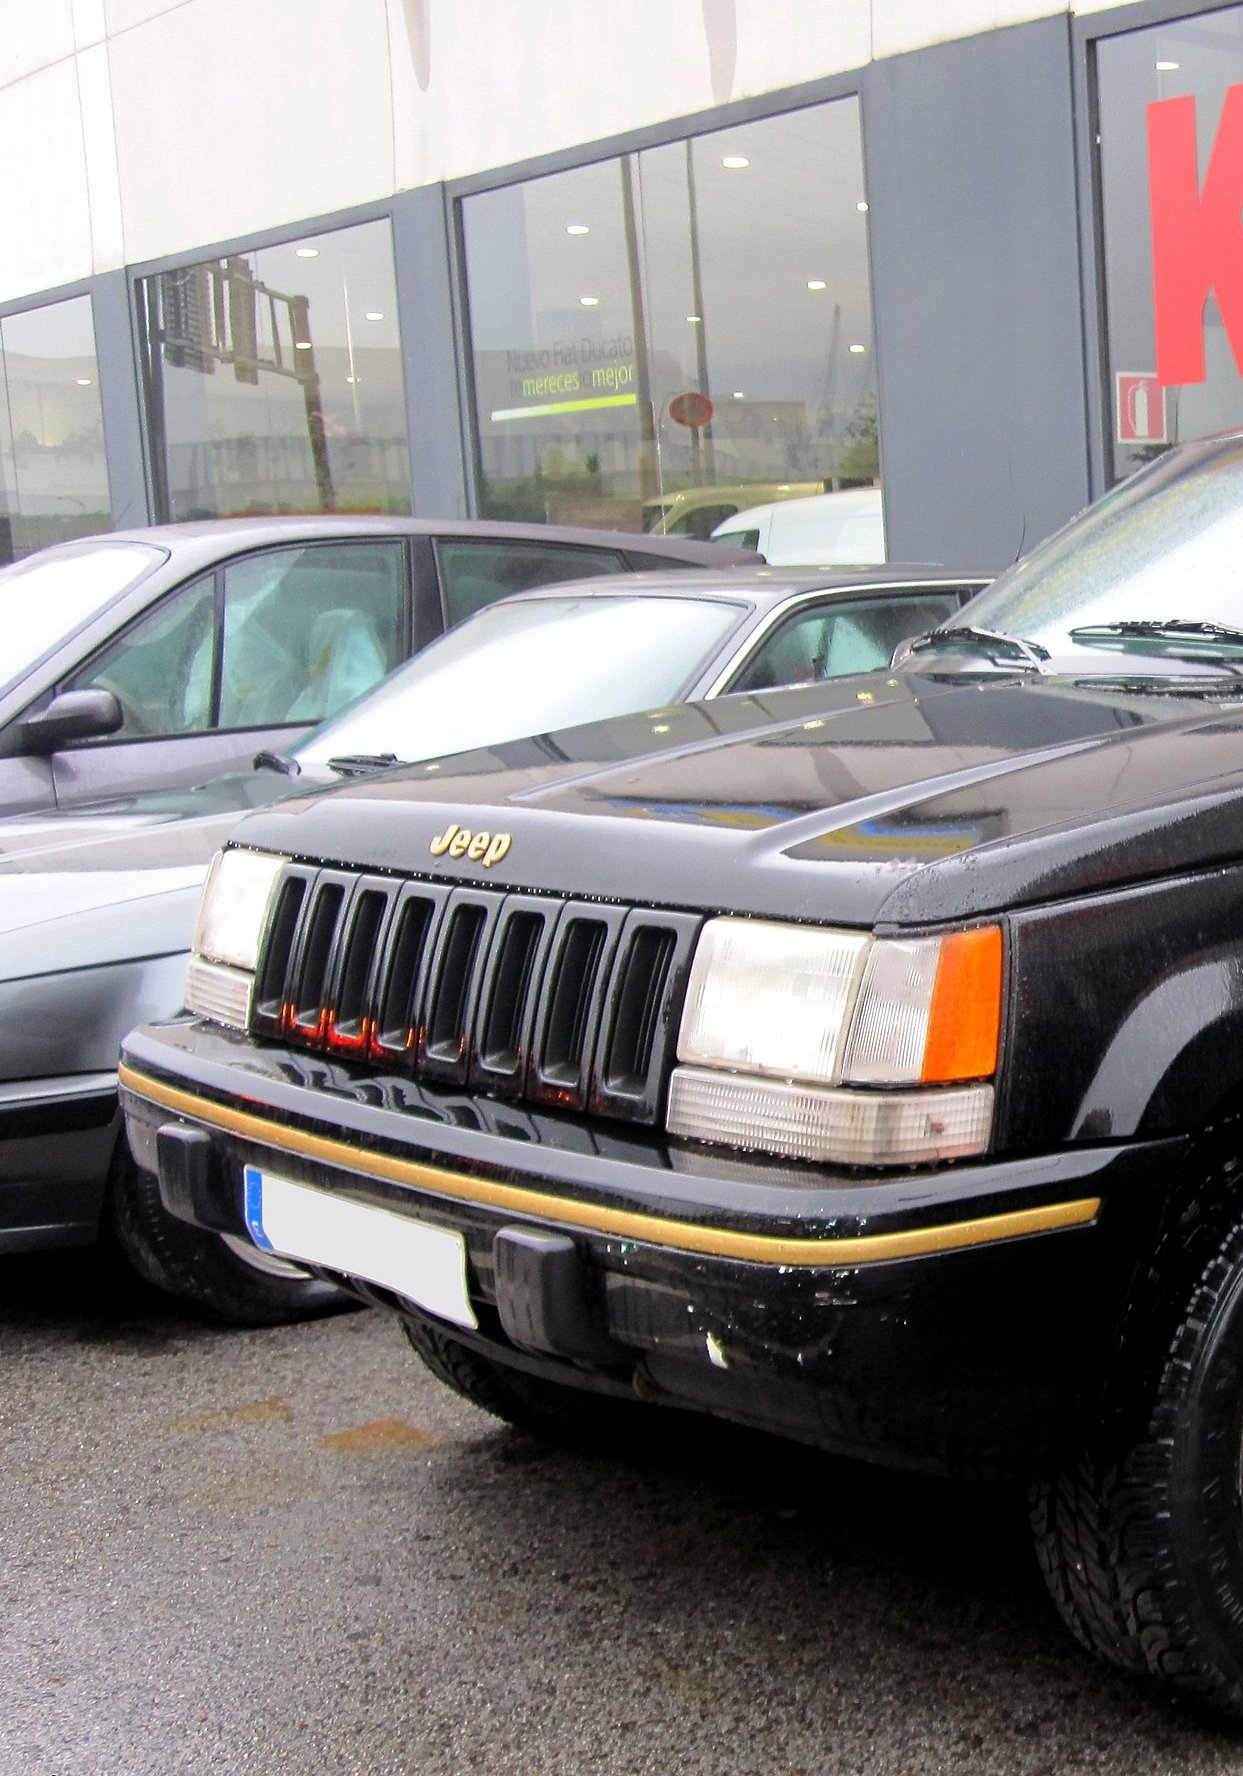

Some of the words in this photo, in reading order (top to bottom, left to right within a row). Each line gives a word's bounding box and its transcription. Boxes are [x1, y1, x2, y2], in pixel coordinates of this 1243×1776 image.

[552, 341, 579, 366] Fiat
[581, 335, 633, 362] Ducato
[522, 371, 580, 397] mereces
[592, 359, 633, 392] mejor
[429, 824, 513, 869] Jeep
